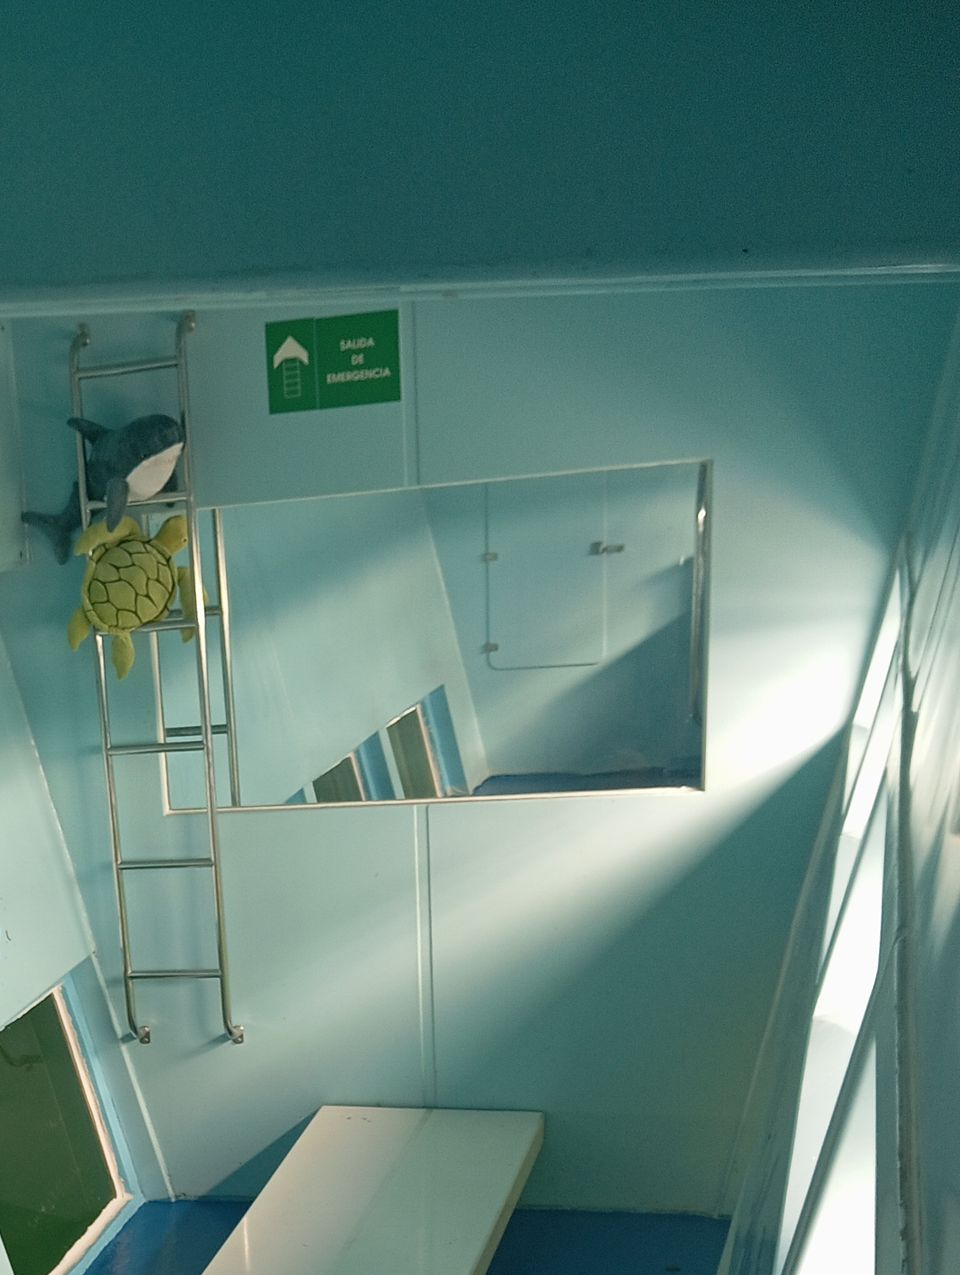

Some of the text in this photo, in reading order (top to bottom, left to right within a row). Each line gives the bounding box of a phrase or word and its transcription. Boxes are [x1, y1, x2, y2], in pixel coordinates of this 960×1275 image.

[340, 337, 375, 351] SALIDA
[351, 353, 364, 366] DE
[327, 367, 391, 384] EMERGENCIA
